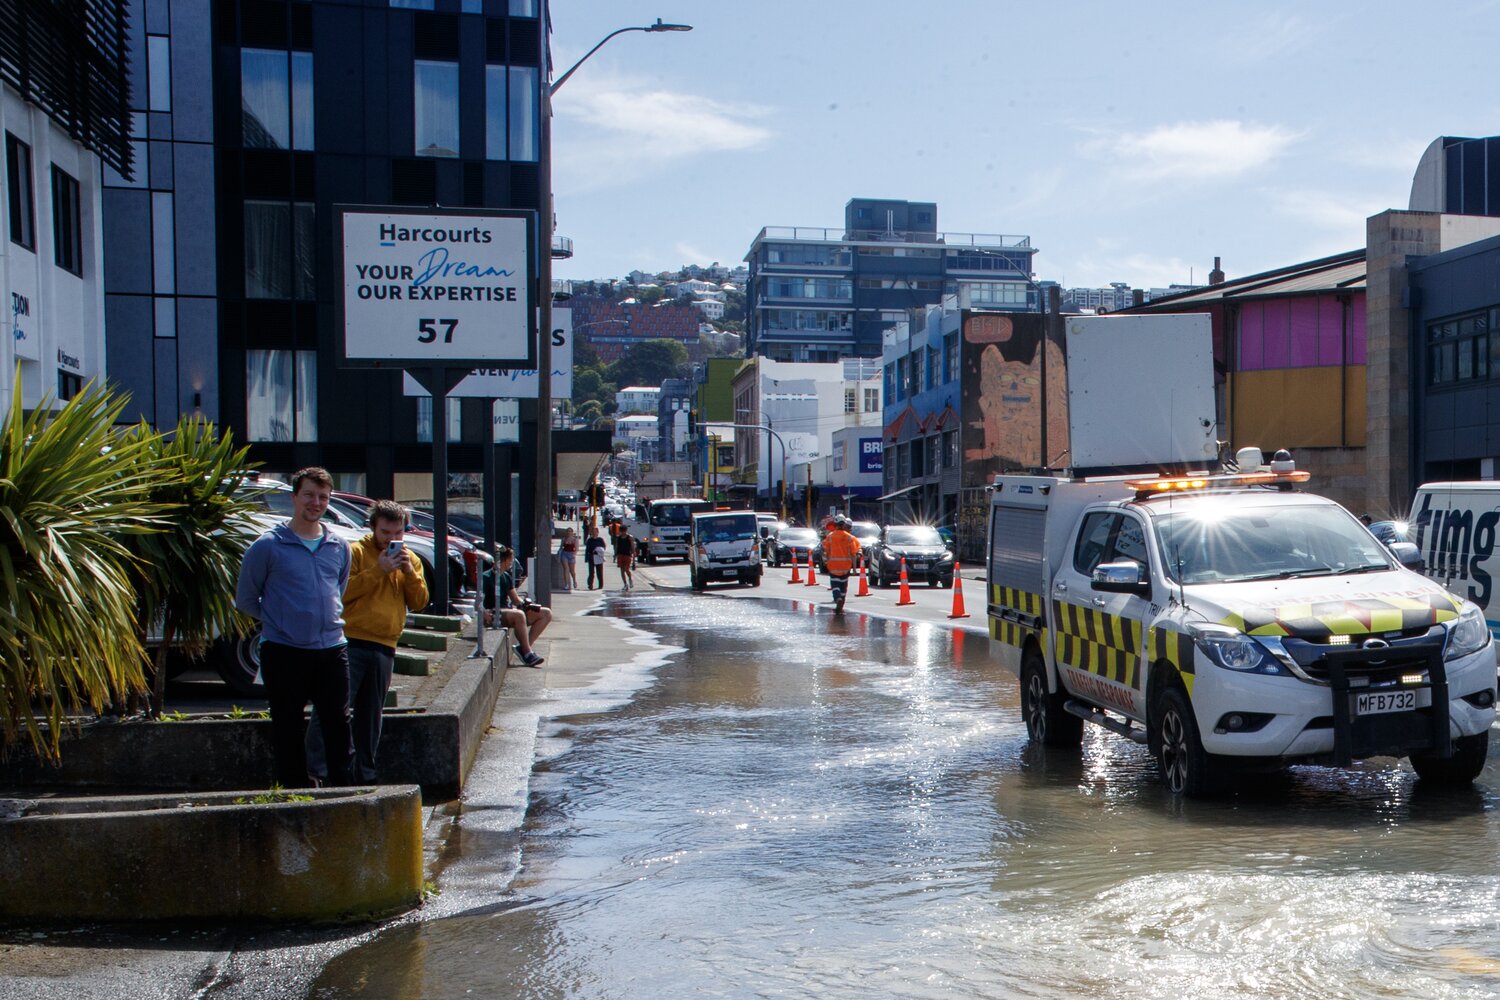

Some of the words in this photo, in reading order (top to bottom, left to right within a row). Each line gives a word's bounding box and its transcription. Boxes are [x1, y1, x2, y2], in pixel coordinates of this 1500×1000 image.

[379, 223, 492, 244] Harcourts
[356, 264, 414, 281] YOUR
[413, 247, 515, 286] Dream
[357, 284, 402, 300] OUR
[408, 285, 517, 302] EXPERTISE
[417, 318, 459, 344] 57
[1416, 493, 1500, 611] timg
[1358, 693, 1415, 714] MFB732
